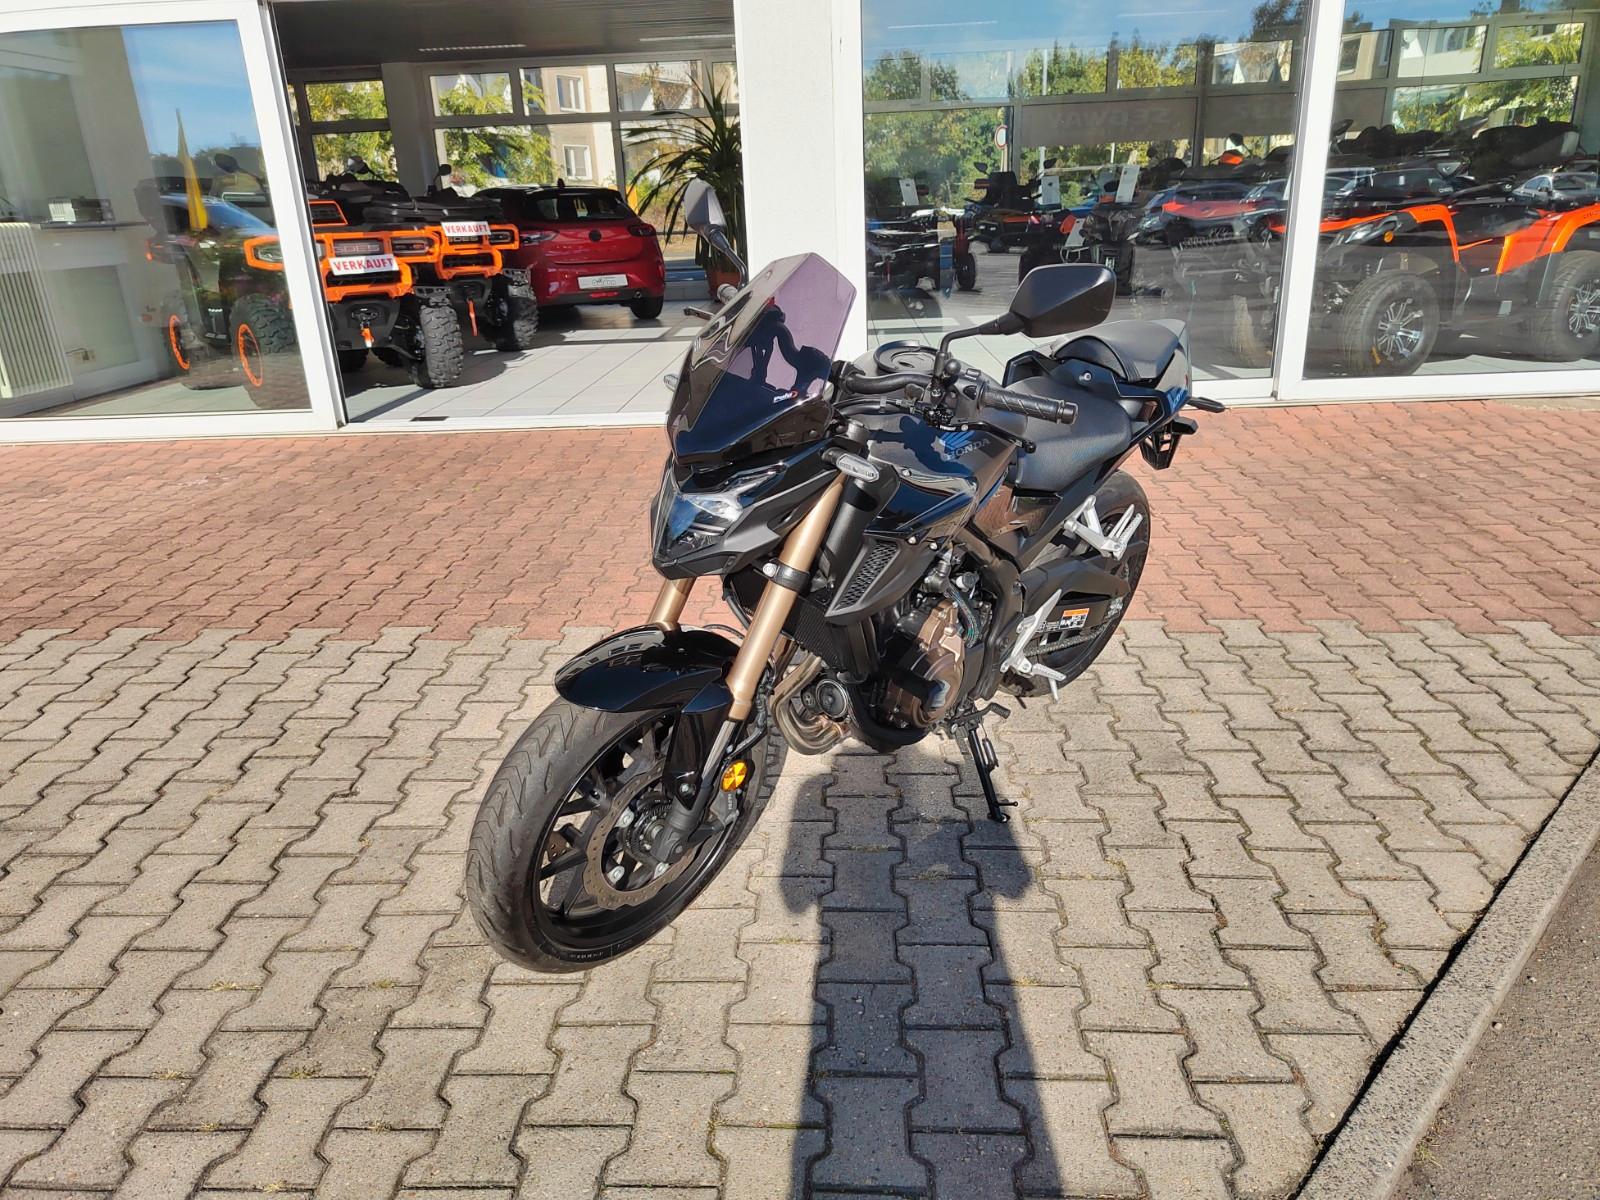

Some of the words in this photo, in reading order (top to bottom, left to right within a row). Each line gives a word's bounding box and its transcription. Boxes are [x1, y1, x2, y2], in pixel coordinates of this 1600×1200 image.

[444, 223, 489, 234] VERKAUFT
[333, 258, 393, 271] VERKAUFT
[944, 439, 991, 460] HONDA
